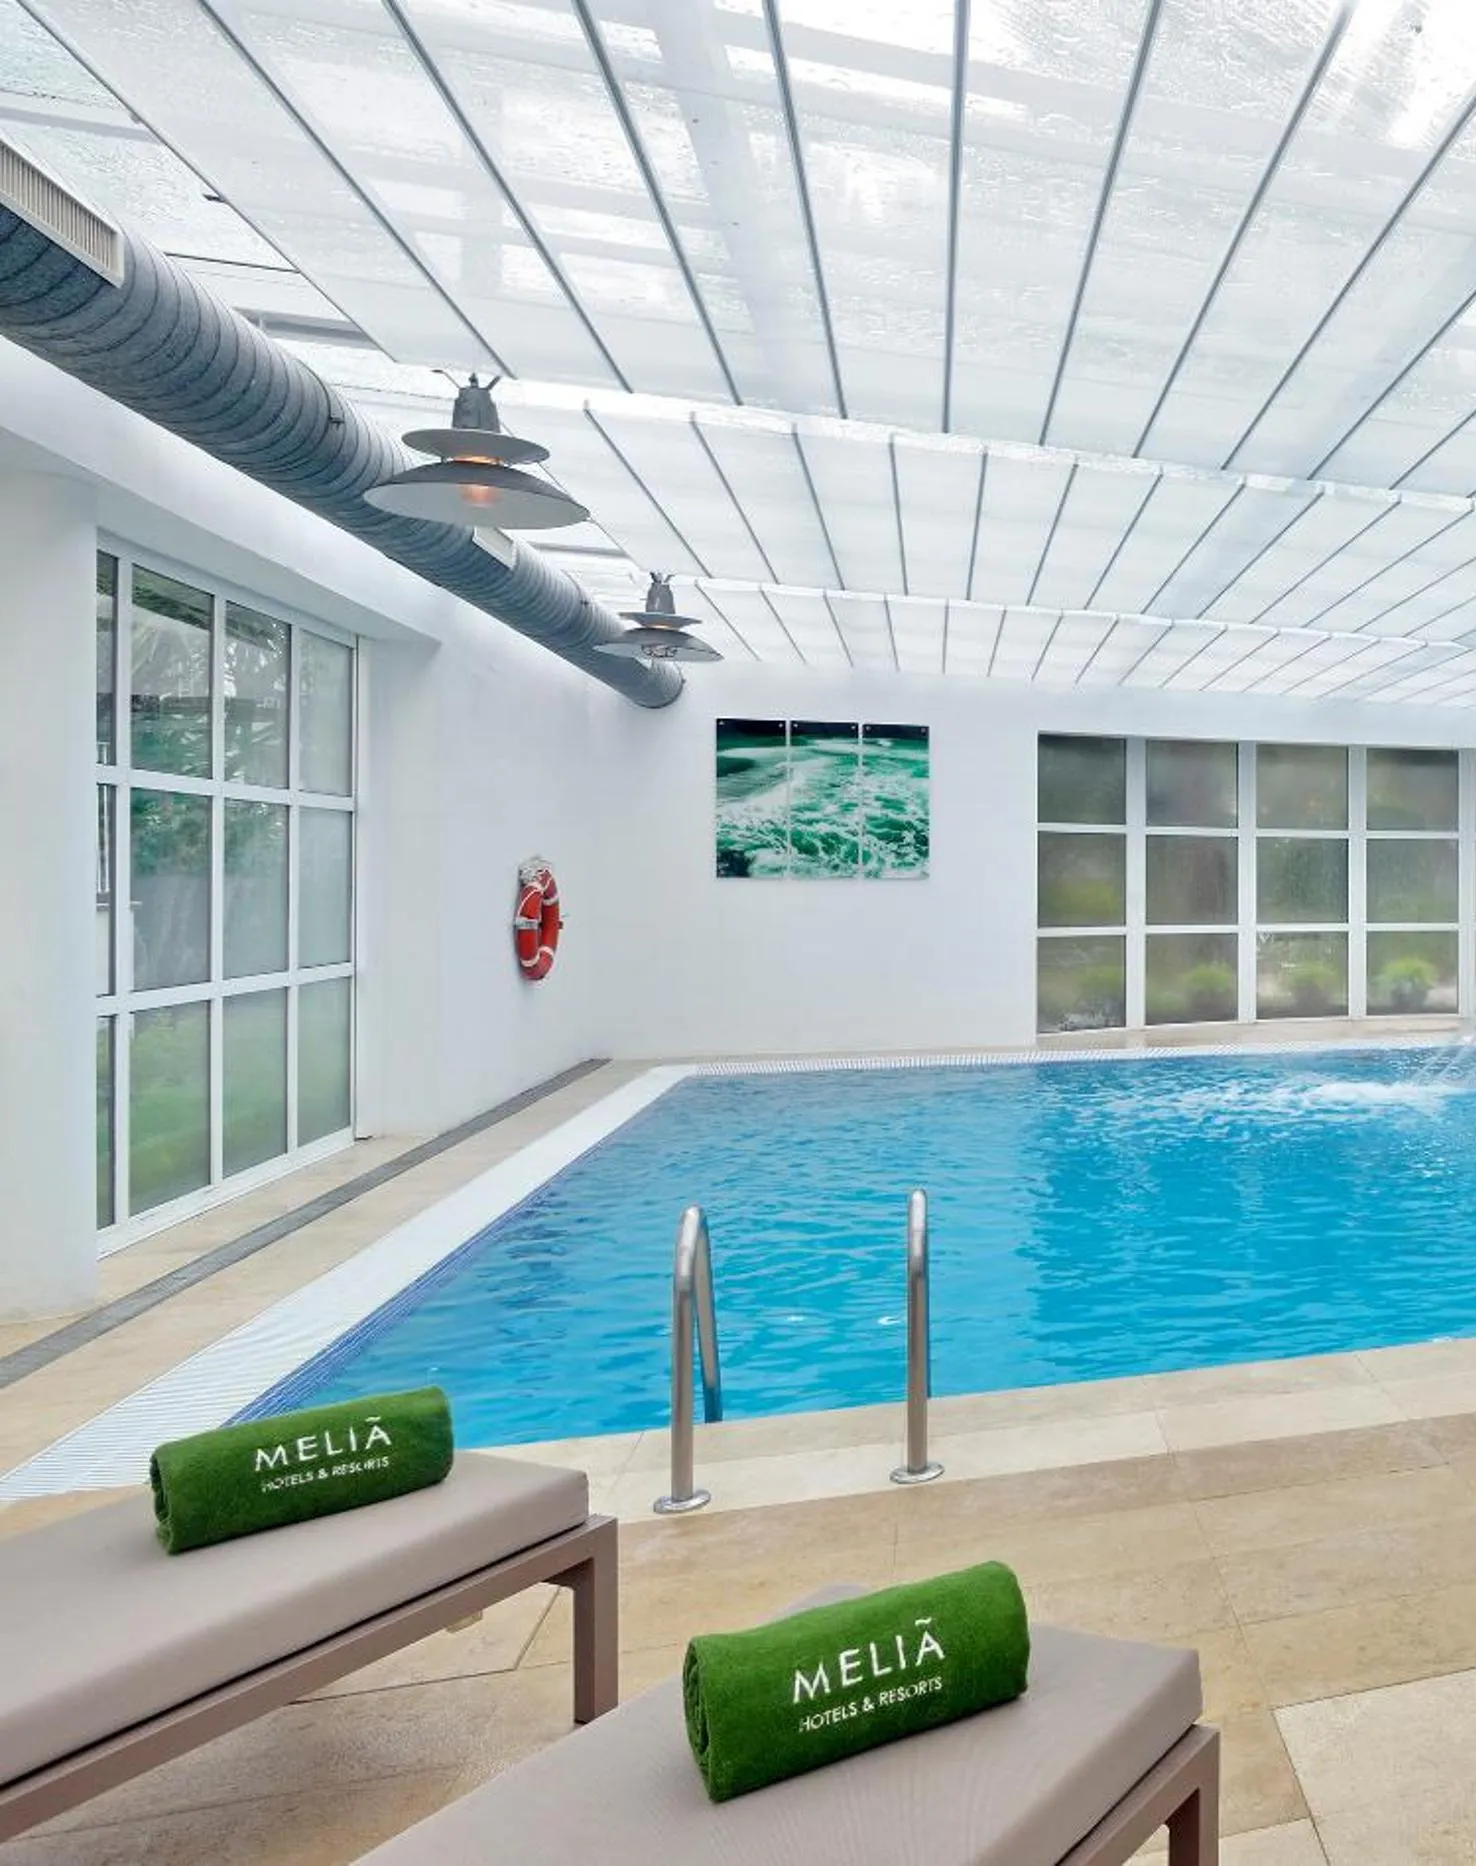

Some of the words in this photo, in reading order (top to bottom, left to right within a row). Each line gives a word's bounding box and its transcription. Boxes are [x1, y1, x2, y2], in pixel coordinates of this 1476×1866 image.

[262, 1471, 314, 1493] HOTELS
[318, 1467, 329, 1480] &
[799, 1702, 857, 1732] HOTELS
[862, 1696, 876, 1711] &
[879, 1676, 943, 1707] RESORTS
